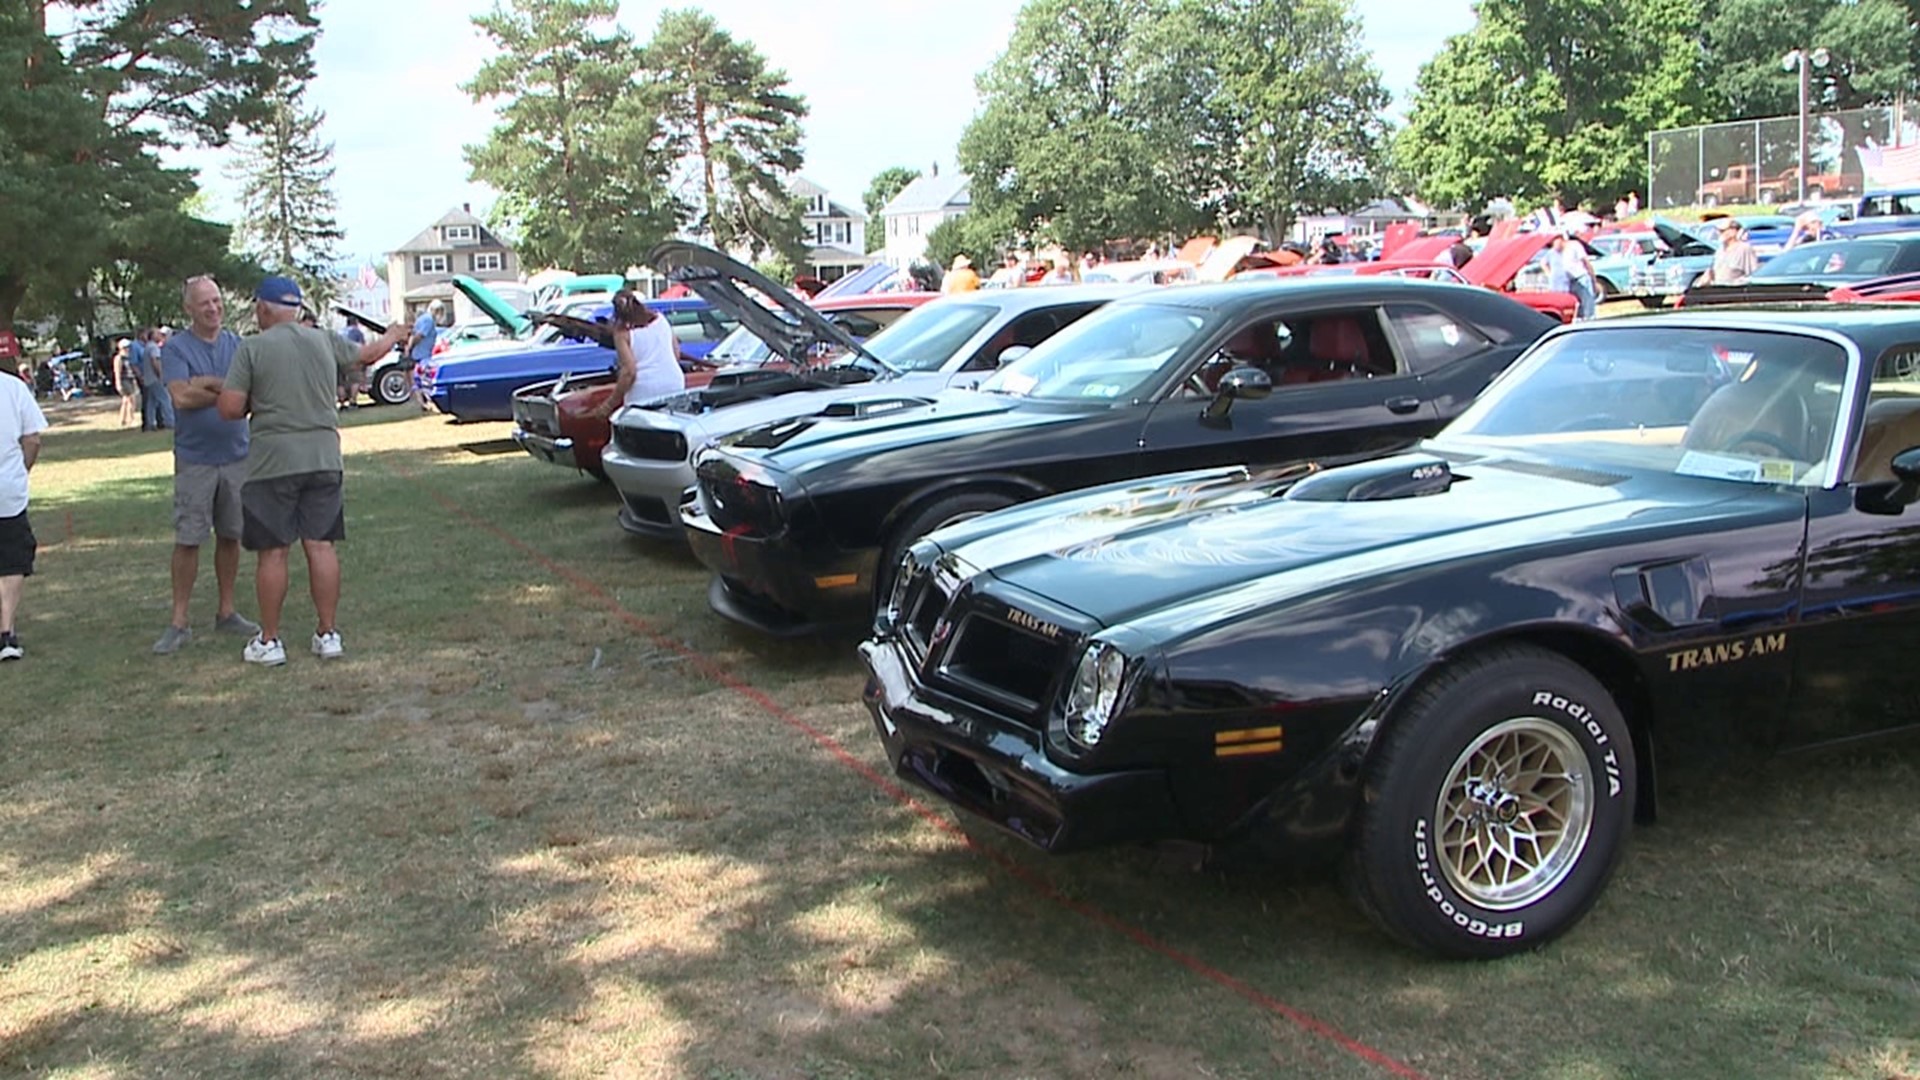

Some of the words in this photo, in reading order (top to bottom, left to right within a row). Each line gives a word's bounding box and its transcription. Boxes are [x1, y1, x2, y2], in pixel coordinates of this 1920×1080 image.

[1667, 641, 1744, 672] TRANS
[1749, 633, 1786, 655] AM
[1532, 691, 1608, 747] Radial
[1604, 749, 1622, 797] T/A
[1414, 819, 1525, 938] BFGoodrich
